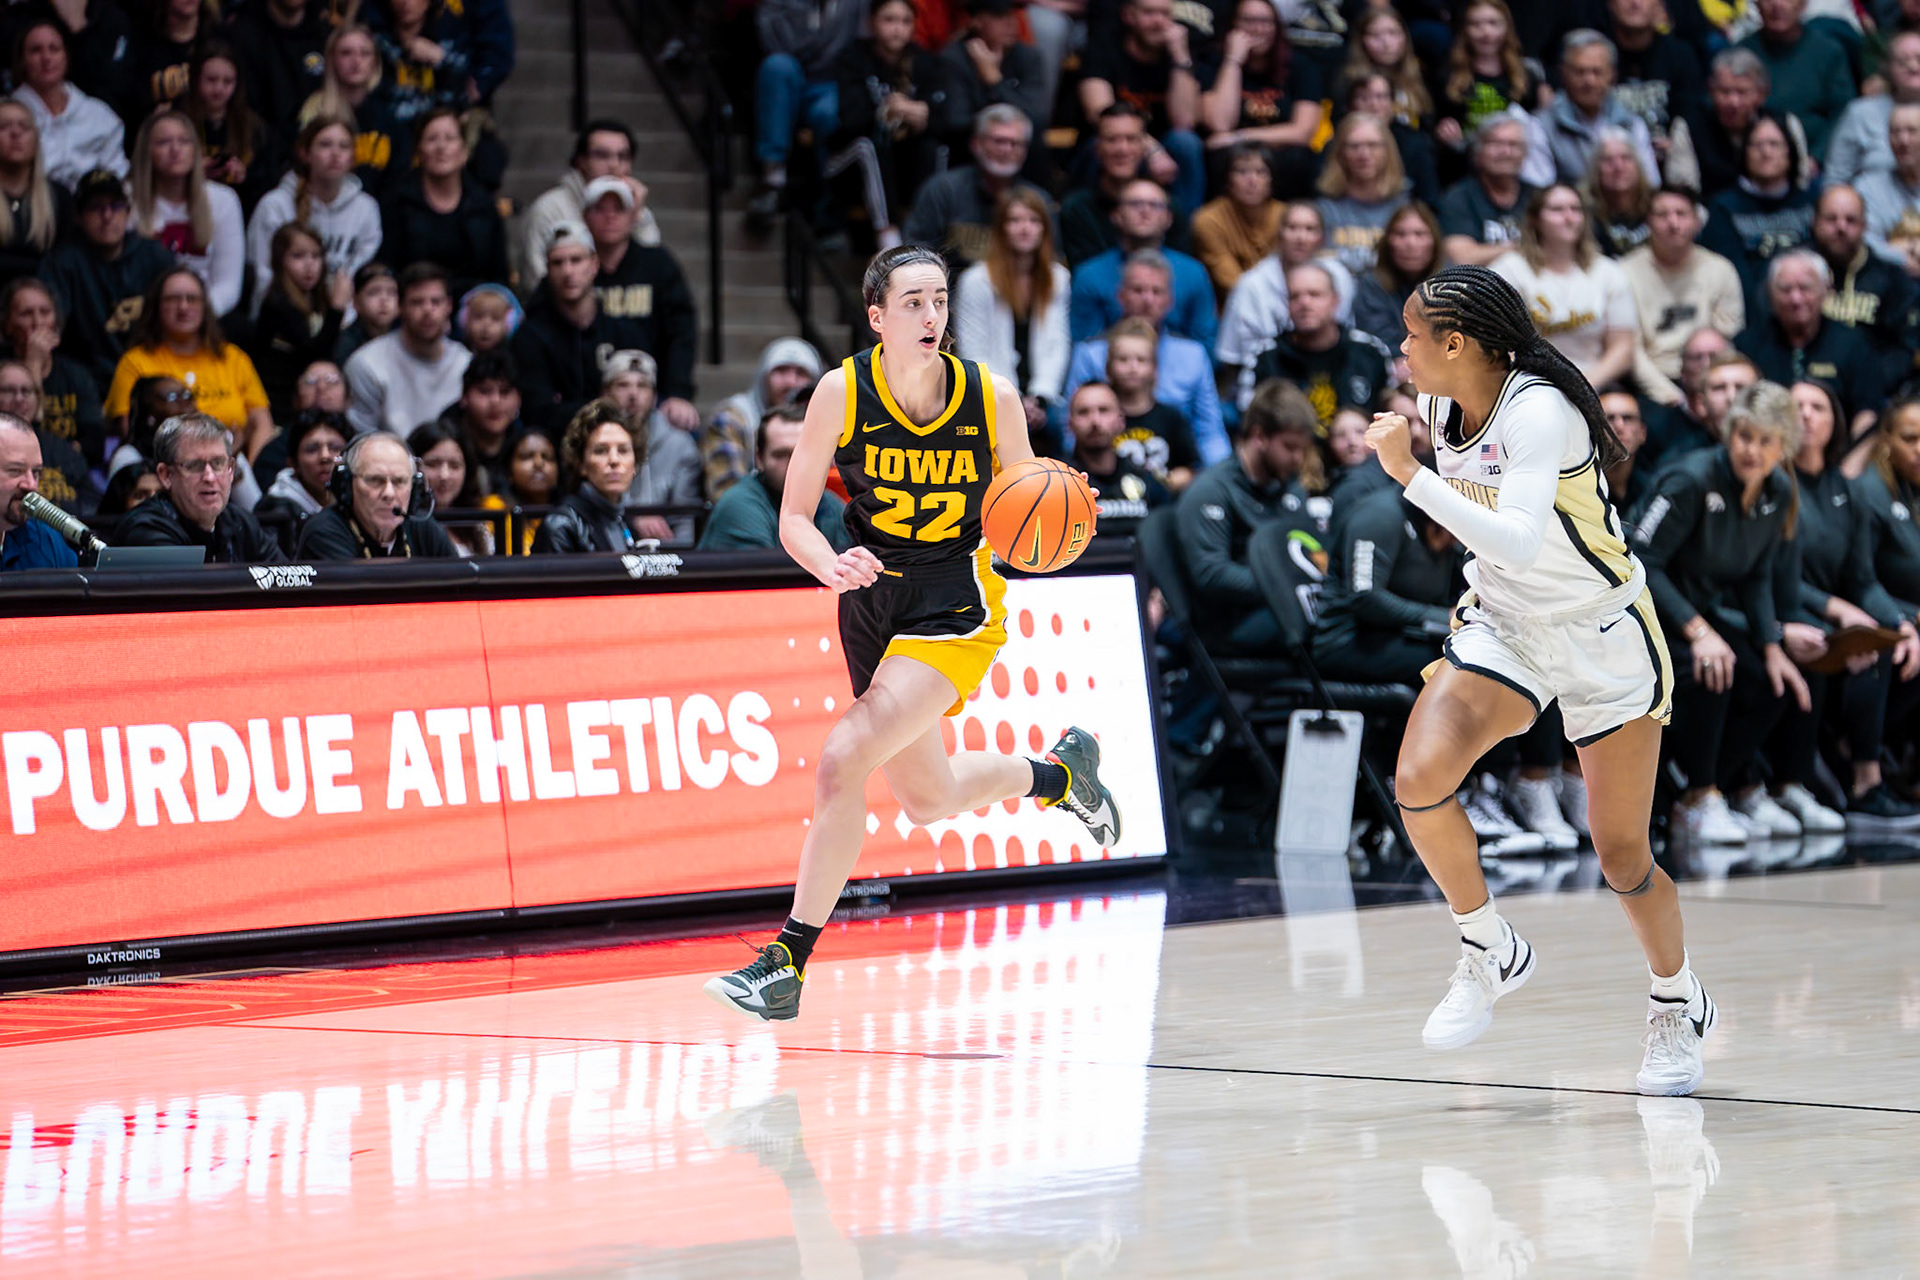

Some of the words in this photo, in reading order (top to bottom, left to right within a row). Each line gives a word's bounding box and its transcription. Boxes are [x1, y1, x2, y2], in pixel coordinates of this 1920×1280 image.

[864, 443, 979, 485] IOWA
[870, 486, 967, 543] 22
[276, 575, 313, 588] GLOBAL
[2, 713, 362, 835] PURDUE
[386, 691, 779, 809] ATHLETICS
[87, 948, 161, 965] DAKTRONICS
